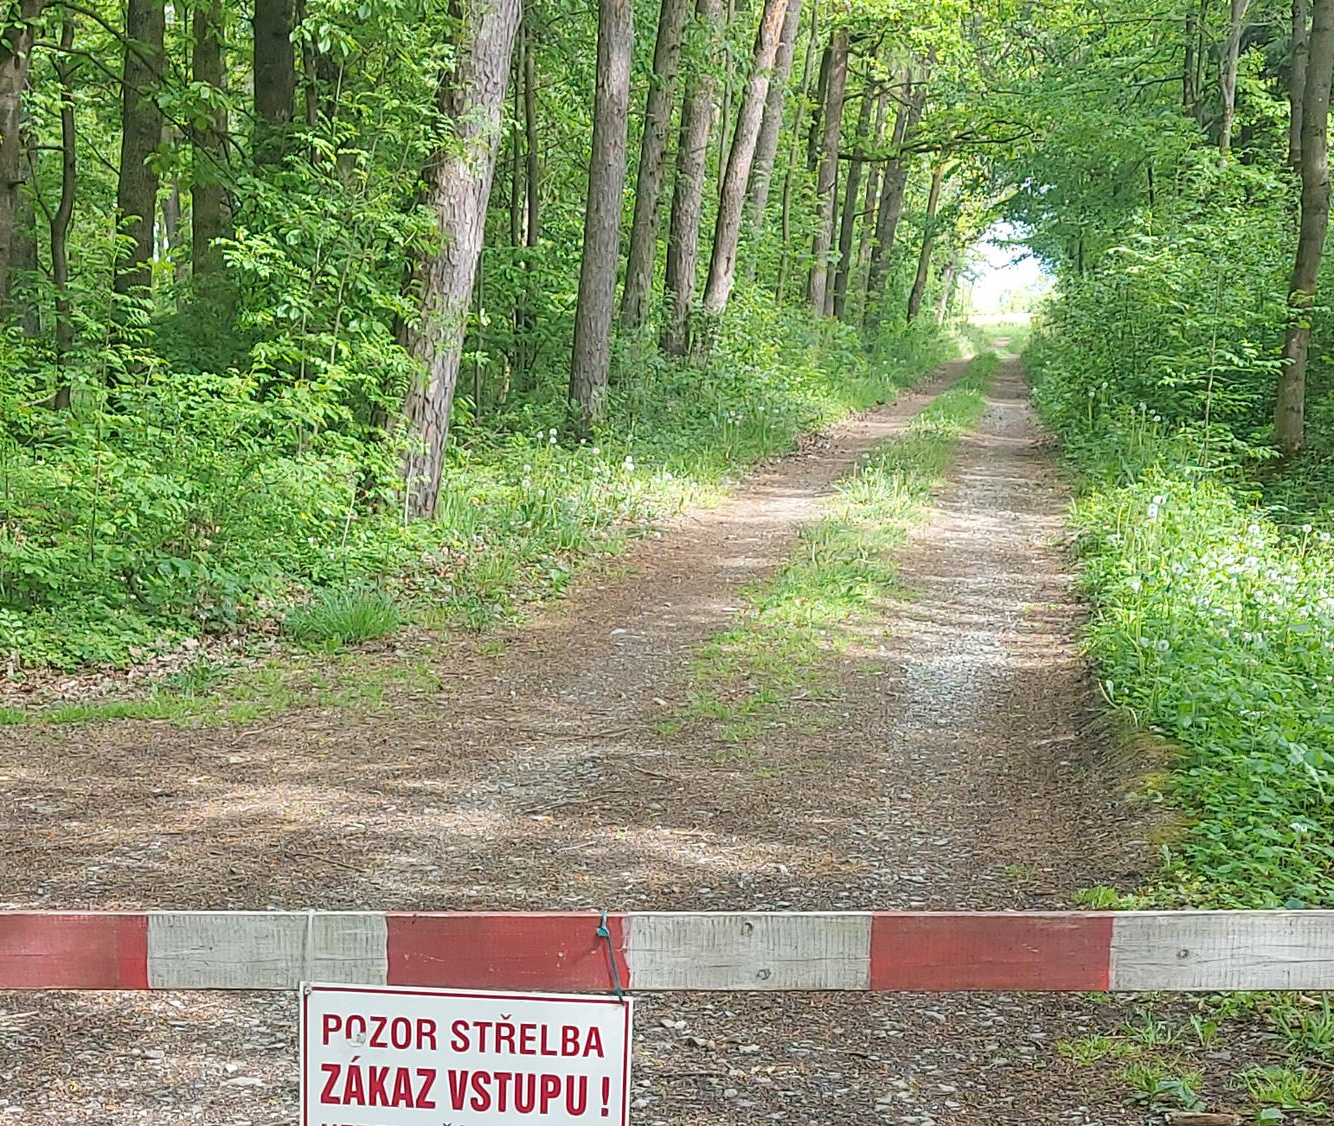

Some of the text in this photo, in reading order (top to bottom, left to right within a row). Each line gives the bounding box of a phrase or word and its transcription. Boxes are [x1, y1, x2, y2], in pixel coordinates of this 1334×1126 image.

[322, 1013, 605, 1059] POZOR STŘELBA
[320, 1055, 610, 1118] ZÁKAZ VSTUPU !
